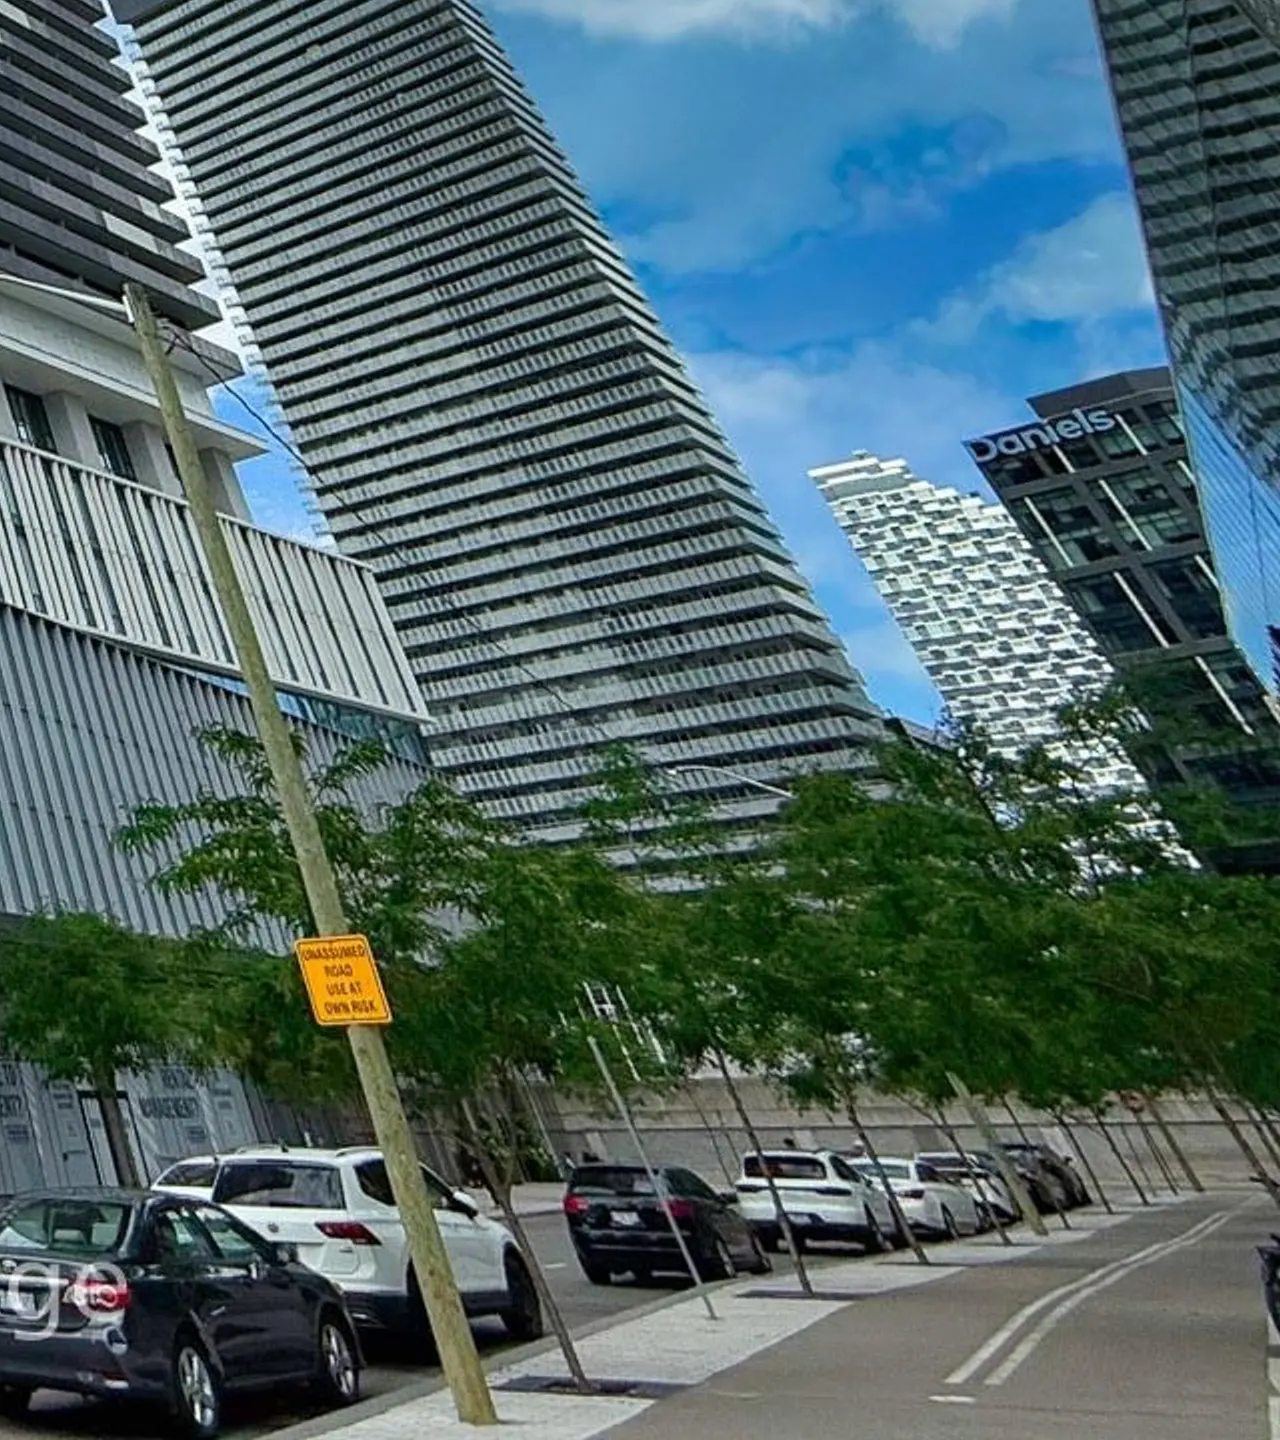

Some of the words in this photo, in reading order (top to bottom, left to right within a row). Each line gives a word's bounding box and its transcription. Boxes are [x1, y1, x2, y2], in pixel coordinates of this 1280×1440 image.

[968, 408, 1116, 462] Daniels
[303, 944, 366, 961] UNASSUMED
[323, 964, 353, 977] ROAD
[326, 983, 348, 996] USE
[350, 982, 362, 994] AT
[324, 1002, 351, 1015] OWN
[351, 1000, 377, 1013] RISK
